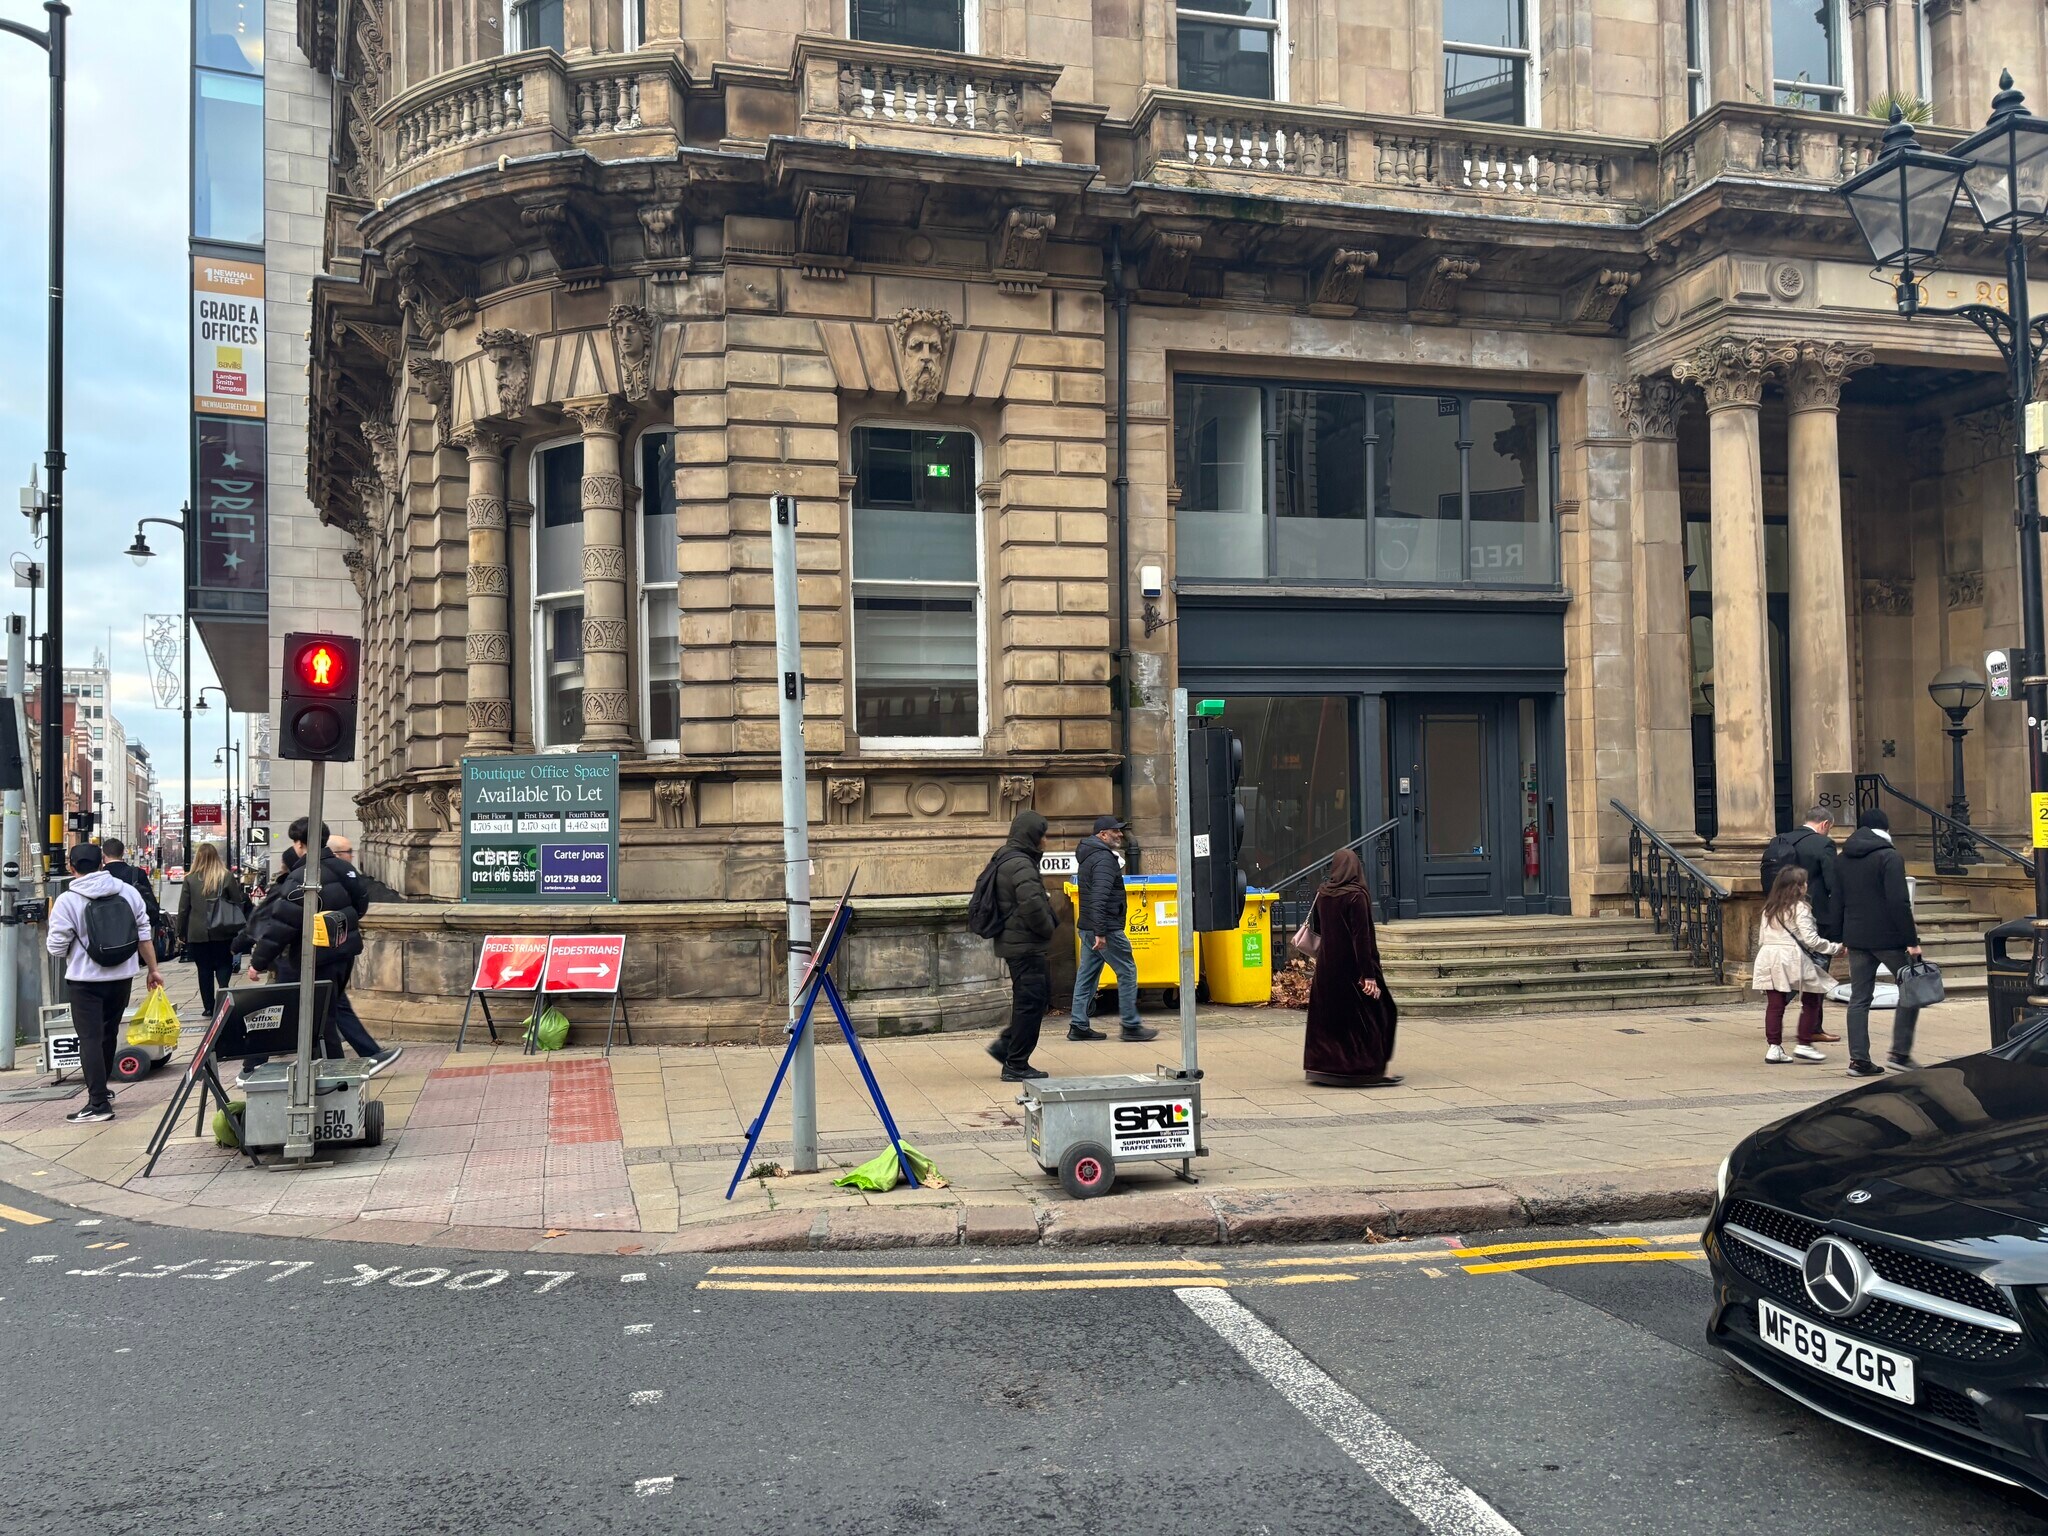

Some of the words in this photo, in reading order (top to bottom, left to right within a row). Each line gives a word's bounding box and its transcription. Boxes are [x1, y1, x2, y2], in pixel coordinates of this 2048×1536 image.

[204, 268, 213, 282] 1
[213, 268, 255, 281] NEWHALL
[213, 275, 245, 286] STREET
[200, 299, 246, 323] GRADE
[249, 306, 259, 325] A
[202, 321, 257, 345] OFFICES
[218, 361, 242, 370] savills
[215, 373, 242, 382] Lambert
[215, 384, 244, 393] Hampton
[210, 479, 255, 543] PRET
[470, 767, 526, 783] Boutique
[530, 765, 570, 779] Office
[574, 764, 610, 780] Space
[476, 785, 549, 803] Available
[552, 785, 572, 802] To
[576, 784, 603, 802] Let
[1818, 791, 1855, 809] 85-8
[473, 822, 491, 832] 1,705
[520, 822, 538, 831] 2,170
[567, 821, 589, 830] 4,462
[472, 850, 519, 866] CBRE
[553, 849, 580, 859] Carter
[581, 849, 605, 861] Jonas
[1037, 858, 1070, 870] ORE
[472, 871, 492, 882] 0121
[494, 871, 510, 882] 616
[512, 871, 536, 882] 5555
[544, 874, 562, 883] 0121
[563, 874, 579, 883] 758
[580, 874, 602, 883] 8202
[485, 943, 547, 953] PEDESTRIANS
[551, 945, 620, 956] PEDESTRIANS
[323, 1109, 346, 1125] EM
[1114, 1104, 1189, 1132] SRL
[1122, 1138, 1168, 1147] SUPPORTING
[1150, 1142, 1186, 1150] INDUSTRY
[65, 1255, 315, 1282] LEFT
[323, 1262, 578, 1294] LOOK
[1765, 1306, 1827, 1363] MF69
[1835, 1338, 1897, 1392] ZGR
